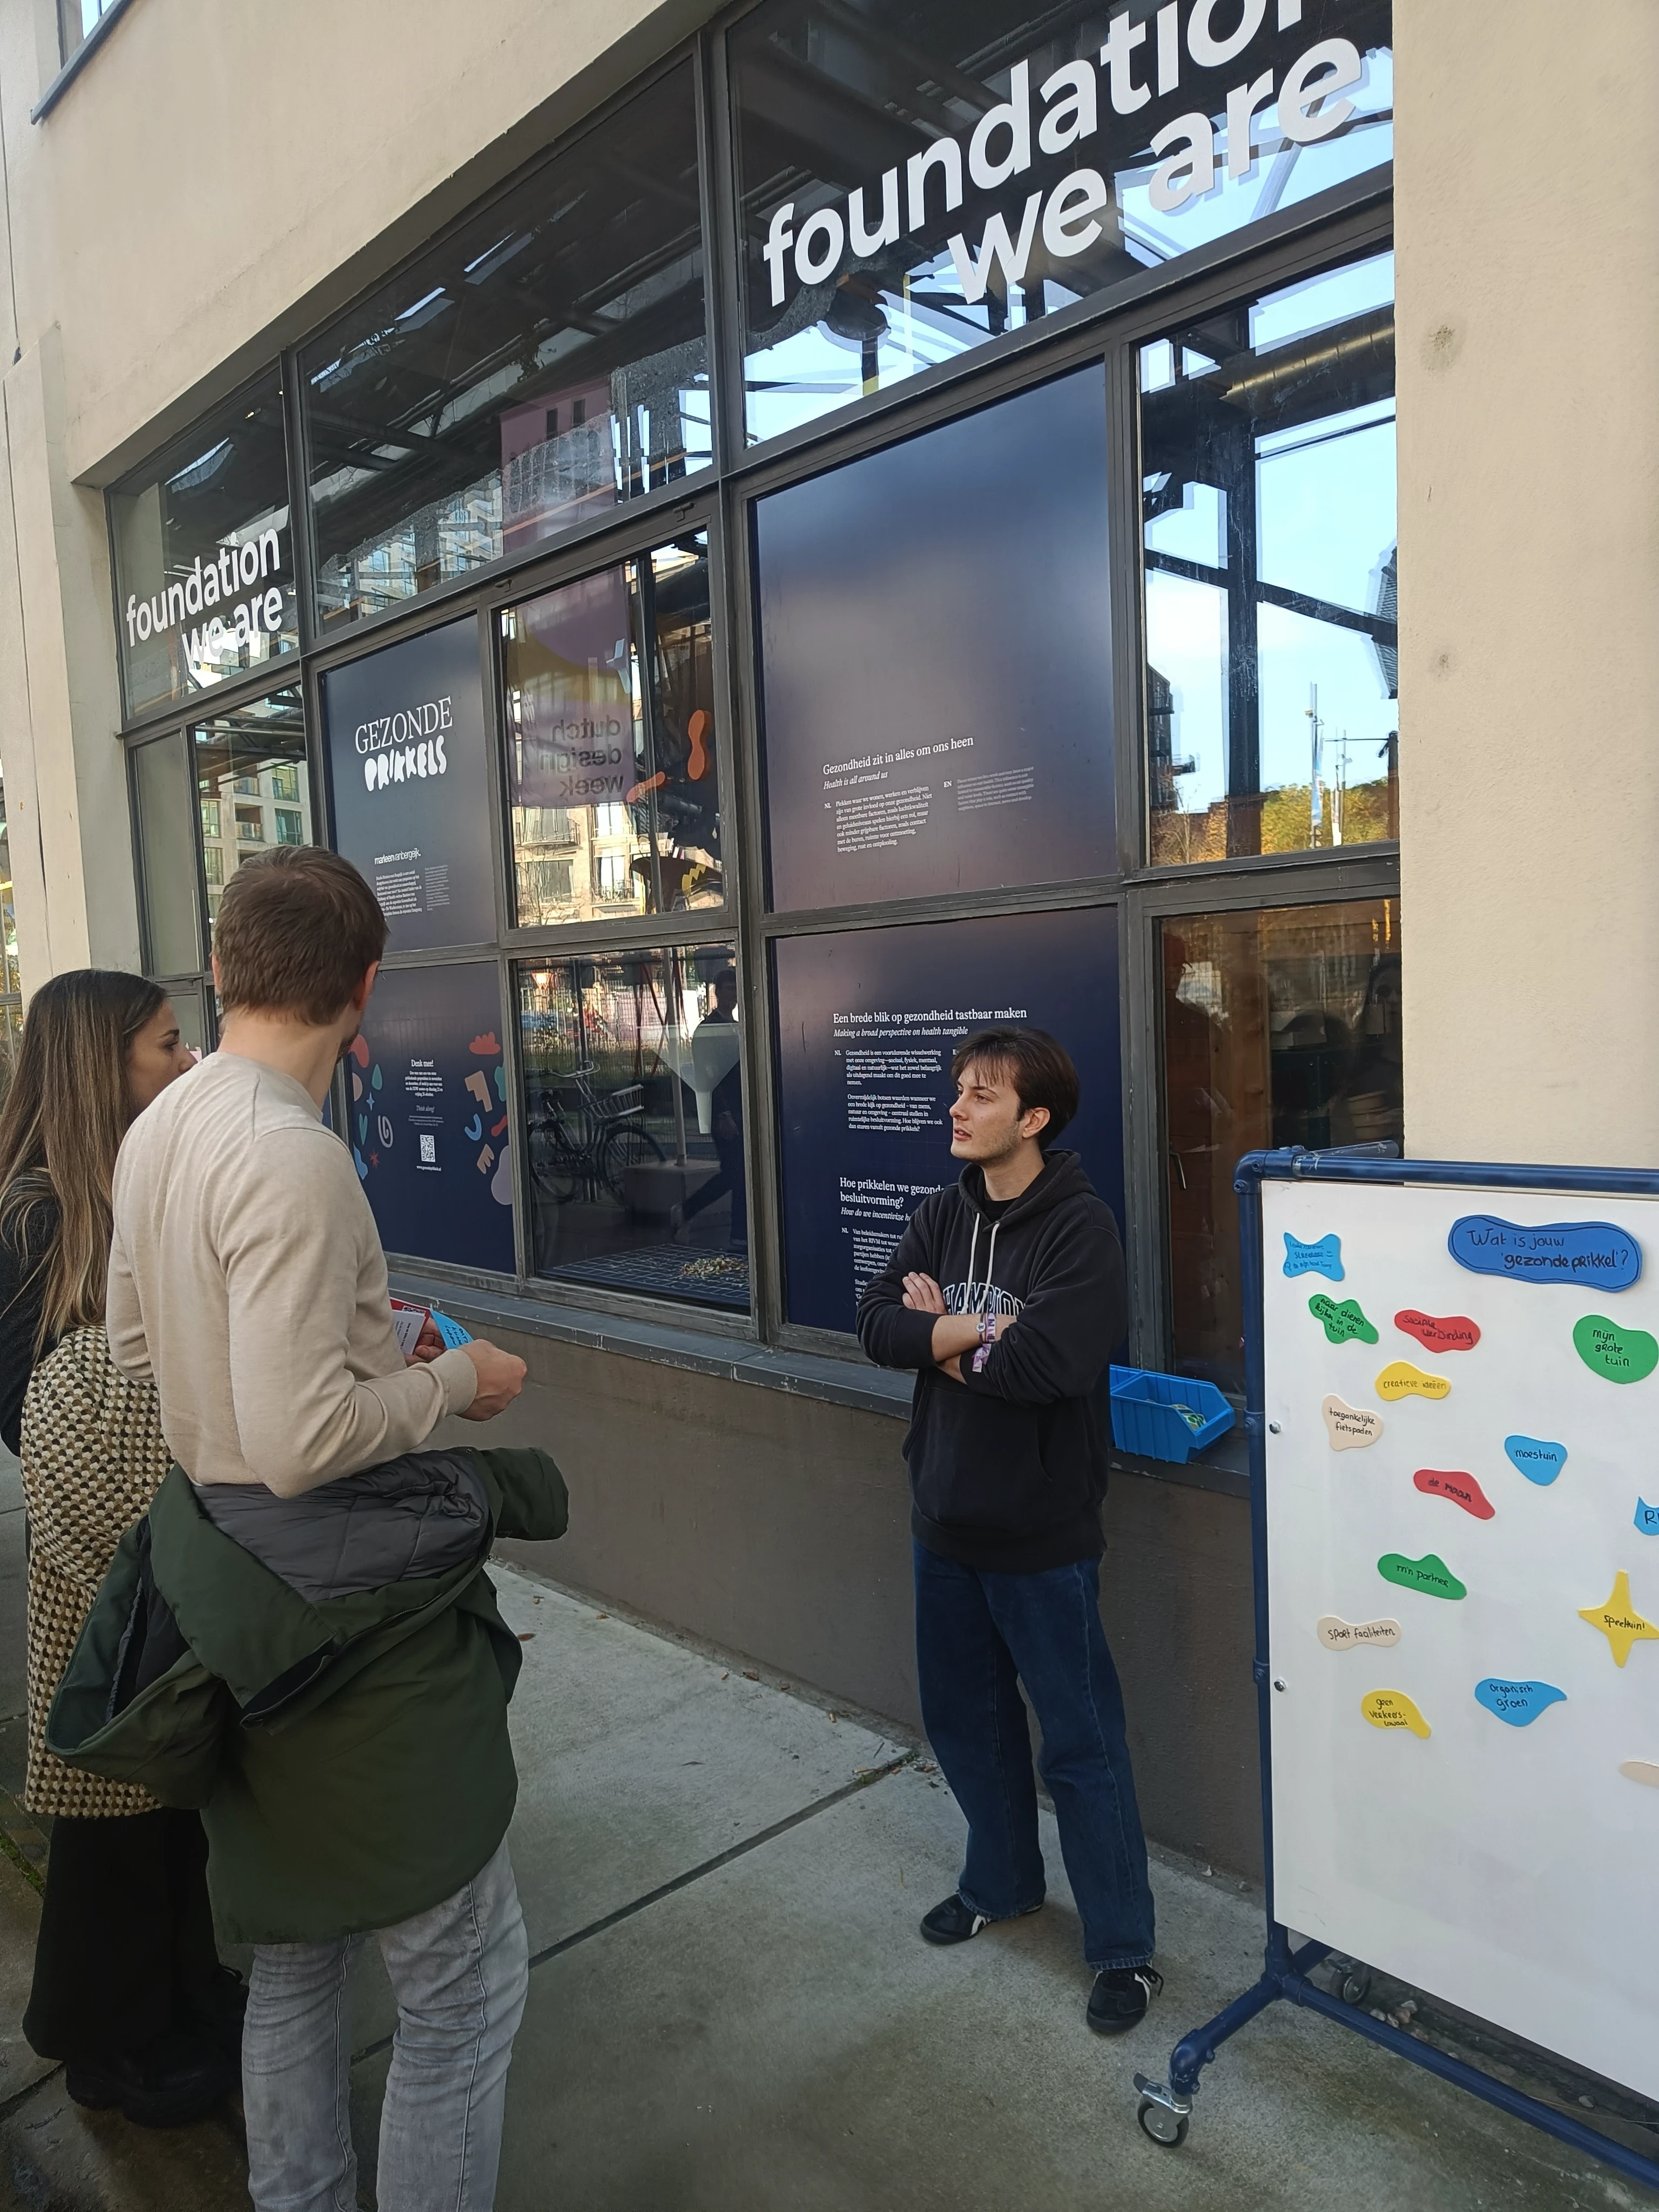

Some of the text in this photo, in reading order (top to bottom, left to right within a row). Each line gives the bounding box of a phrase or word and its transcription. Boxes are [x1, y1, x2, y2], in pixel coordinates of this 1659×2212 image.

[763, 0, 1340, 306] foundatio
[947, 37, 1361, 305] we are
[126, 528, 280, 647] foundation
[181, 587, 283, 669] we are
[355, 695, 453, 754] GEZONDE
[365, 735, 447, 792] PRIKKELS
[823, 736, 974, 774] Gezondheid zit in alles om ons heen
[824, 778, 842, 790] Health
[849, 775, 858, 785] all
[859, 772, 880, 783] around
[881, 771, 888, 779] us
[833, 1007, 1027, 1024] Een brede blik op gezondheid tastbaar maken
[833, 1029, 855, 1038] Making
[861, 1028, 878, 1037] broad
[879, 1028, 911, 1038] perspective
[921, 1027, 941, 1036] health
[942, 1027, 968, 1037] tangible
[411, 1059, 423, 1067] Denk
[840, 1177, 856, 1188] Hoe
[858, 1179, 895, 1192] prikkelen
[896, 1184, 909, 1192] we
[840, 1191, 904, 1209] besluitvorming?
[841, 1207, 854, 1215] How
[855, 1208, 862, 1216] do
[872, 1210, 904, 1221] incentivize
[1467, 1228, 1564, 1250] Wat is jouw
[1320, 1298, 1364, 1327] naar dieren
[1328, 1323, 1345, 1337] tuin
[1337, 1317, 1343, 1325] in
[1347, 1324, 1358, 1334] de
[1606, 1354, 1630, 1367] tuin
[1384, 1378, 1418, 1389] creatieve
[1329, 1407, 1375, 1426] toegankelijke
[1515, 1449, 1558, 1461] moestuin
[1644, 1510, 1659, 1525] R
[1376, 1698, 1394, 1710] geen
[1496, 1698, 1528, 1711] groen
